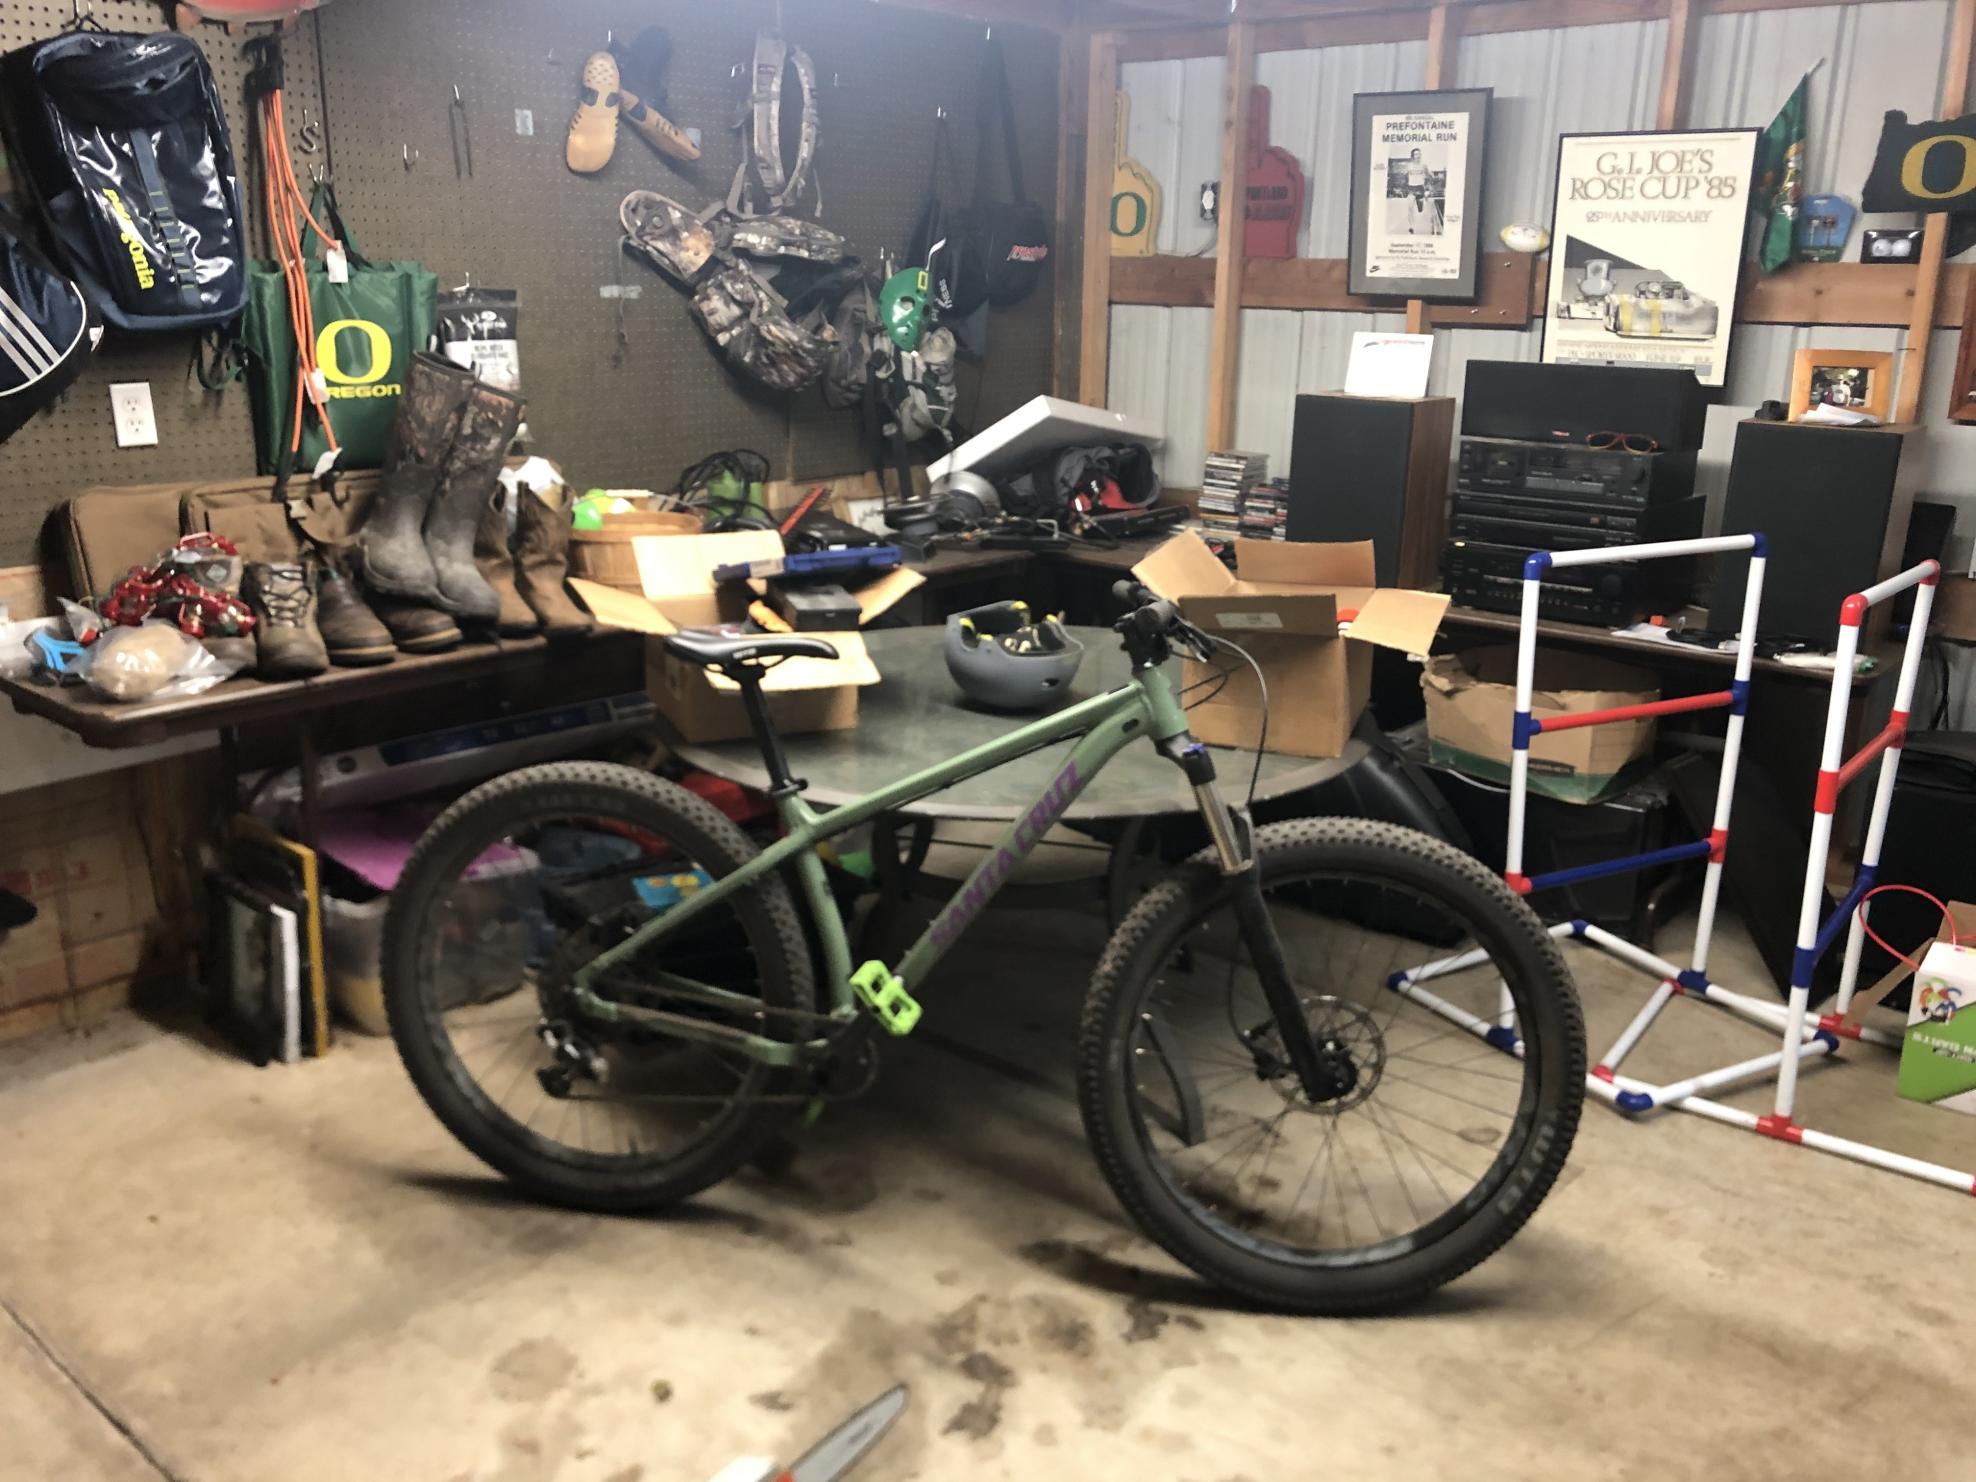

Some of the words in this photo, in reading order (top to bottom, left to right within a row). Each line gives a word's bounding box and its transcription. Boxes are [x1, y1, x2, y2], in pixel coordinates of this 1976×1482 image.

[1382, 133, 1432, 143] MEMORIAL
[1436, 132, 1457, 142] RUN
[1386, 120, 1455, 131] PREFONTAINE
[1647, 148, 1714, 175] JOE'S
[1902, 134, 1976, 199] O
[1569, 176, 1635, 201] ROSE
[1640, 175, 1700, 200] CUP
[1704, 175, 1738, 199] '85
[1110, 191, 1147, 237] O
[102, 187, 155, 290] patgonia
[316, 319, 392, 384] O
[326, 384, 402, 398] REGON
[1013, 759, 1083, 853] CRUZ
